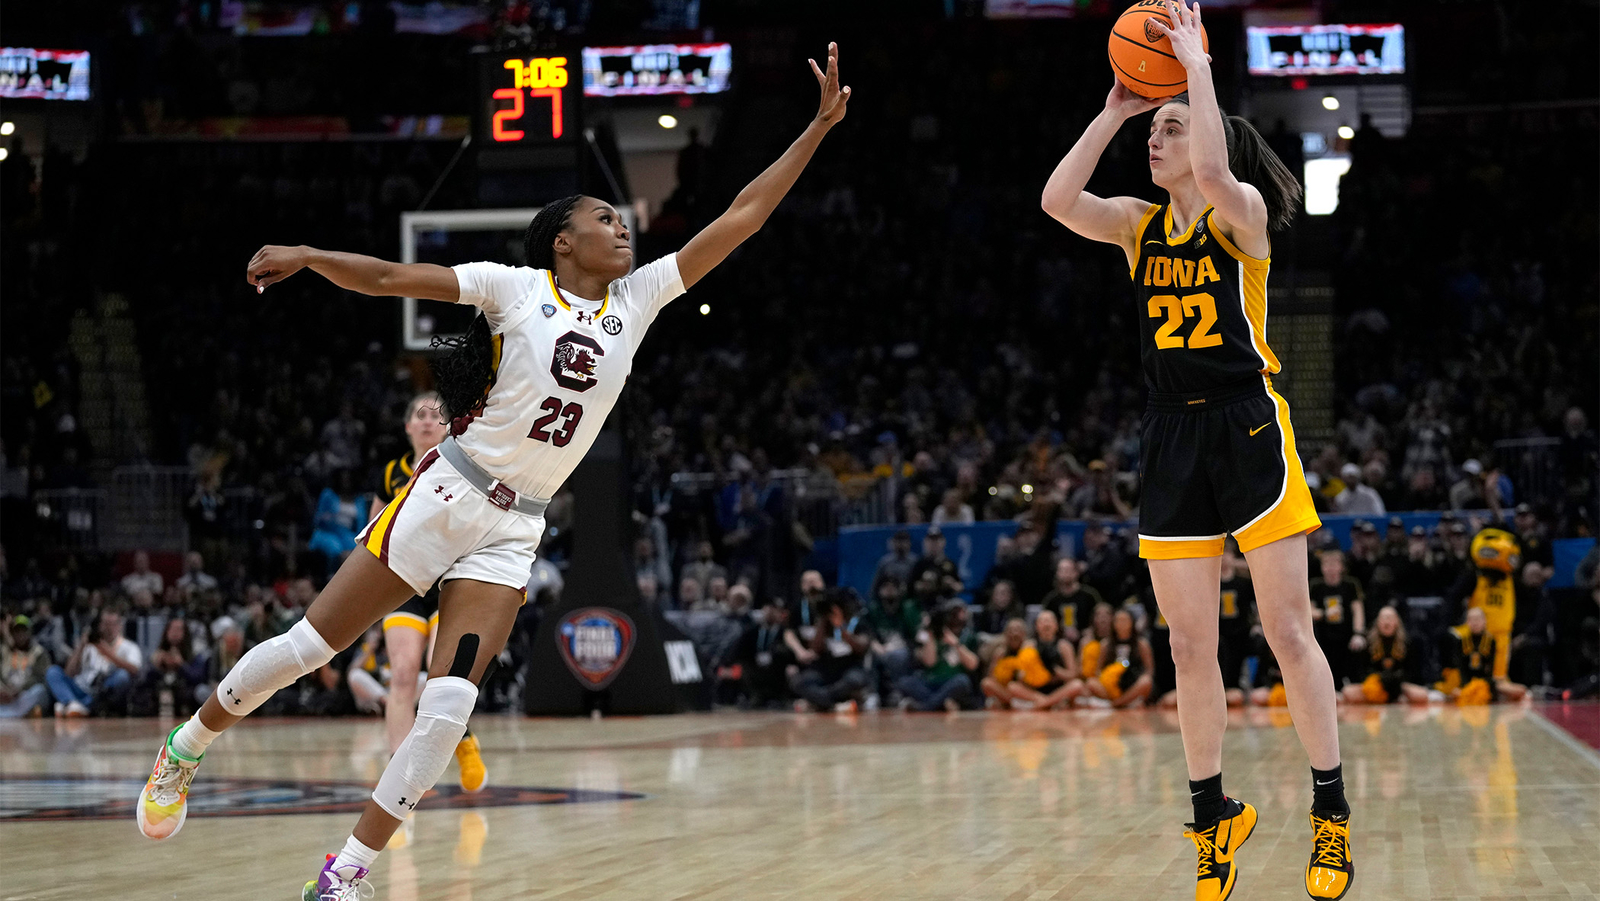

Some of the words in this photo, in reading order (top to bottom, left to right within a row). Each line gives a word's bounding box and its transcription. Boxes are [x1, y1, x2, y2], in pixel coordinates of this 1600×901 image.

[504, 57, 568, 88] 7:06
[492, 88, 563, 142] 27
[1144, 255, 1221, 288] IOWA
[604, 317, 621, 334] SEC
[1147, 292, 1223, 350] 22
[526, 396, 583, 448] 23
[574, 625, 615, 641] FINAL
[574, 641, 617, 658] FOUR
